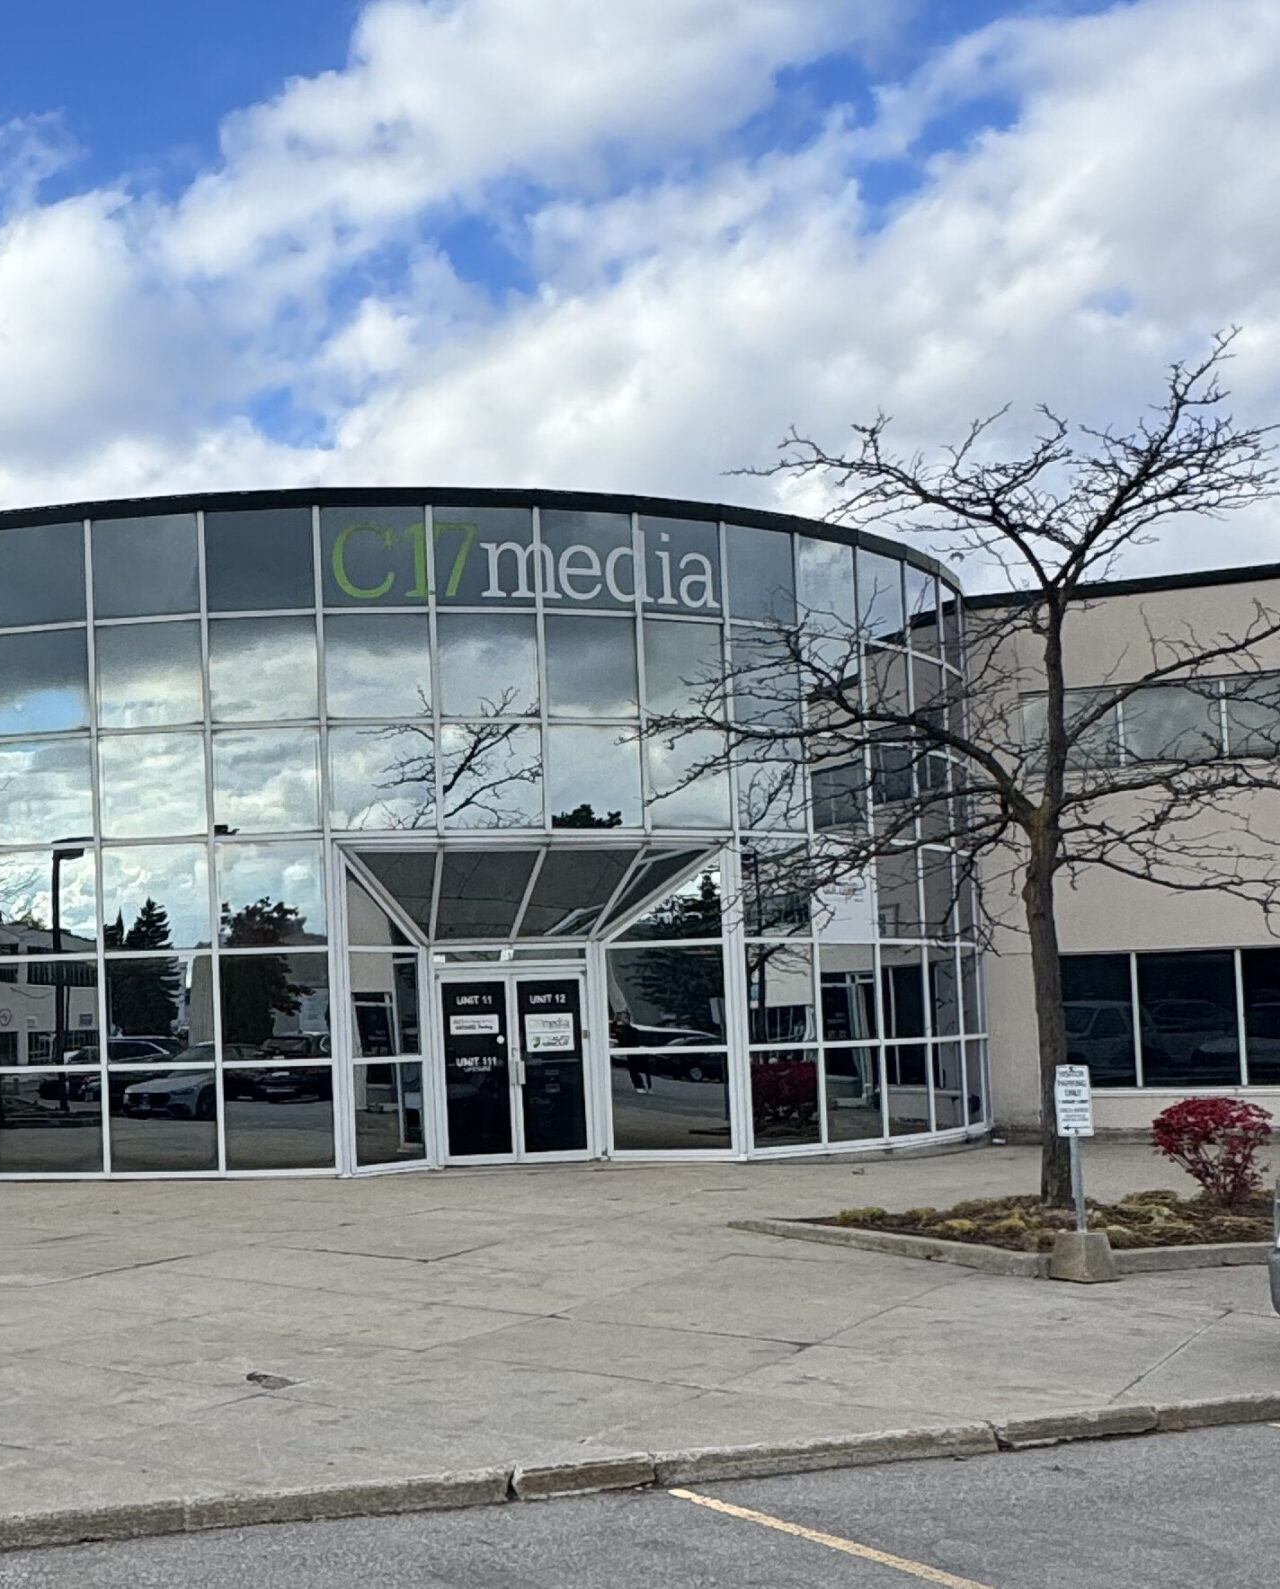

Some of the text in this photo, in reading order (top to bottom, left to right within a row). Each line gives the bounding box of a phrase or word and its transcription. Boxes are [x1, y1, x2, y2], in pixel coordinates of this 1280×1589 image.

[331, 520, 721, 608] C17media
[455, 995, 492, 1006] UNIT 11
[529, 993, 567, 1004] UNIT 12
[455, 1056, 480, 1067] UNIT
